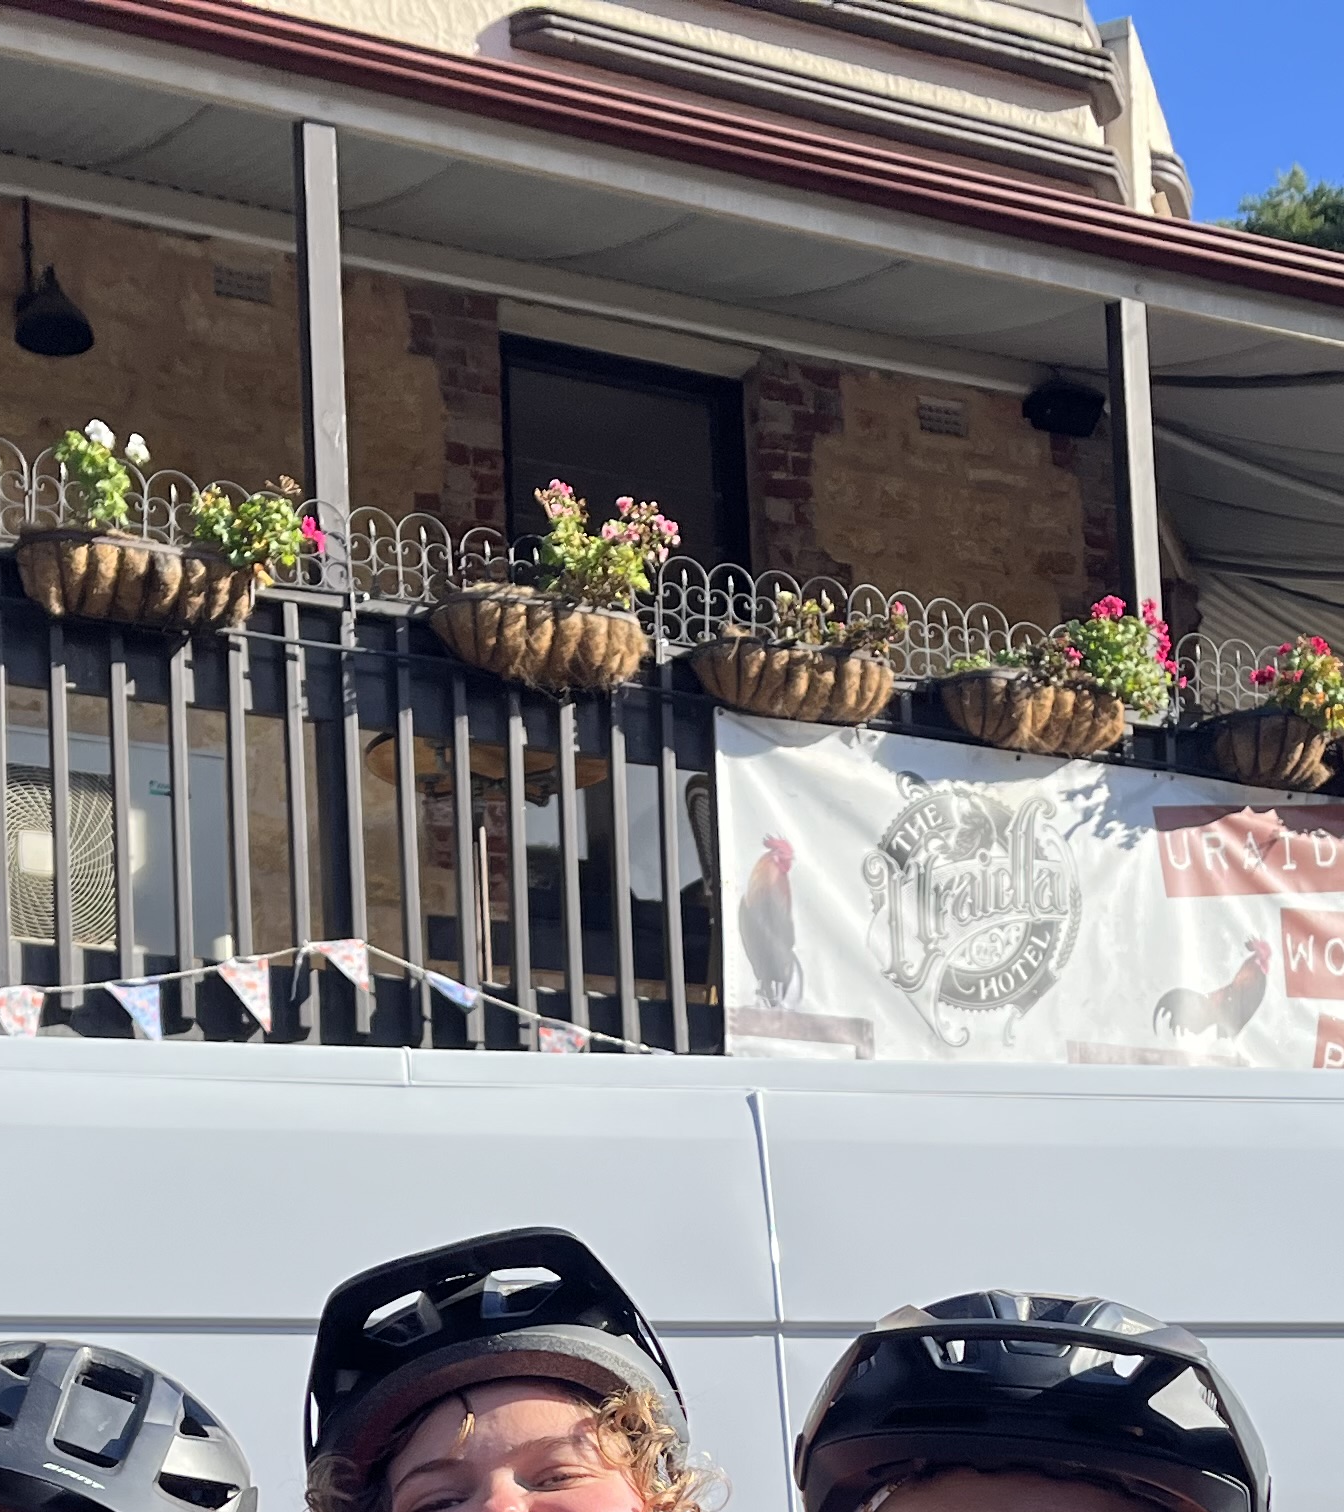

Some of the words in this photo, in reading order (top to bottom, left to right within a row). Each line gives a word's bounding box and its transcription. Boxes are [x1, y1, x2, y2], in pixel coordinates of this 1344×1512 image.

[892, 803, 943, 854] THE
[863, 796, 1067, 992] Uraidla
[978, 929, 1051, 1000] HOTEL
